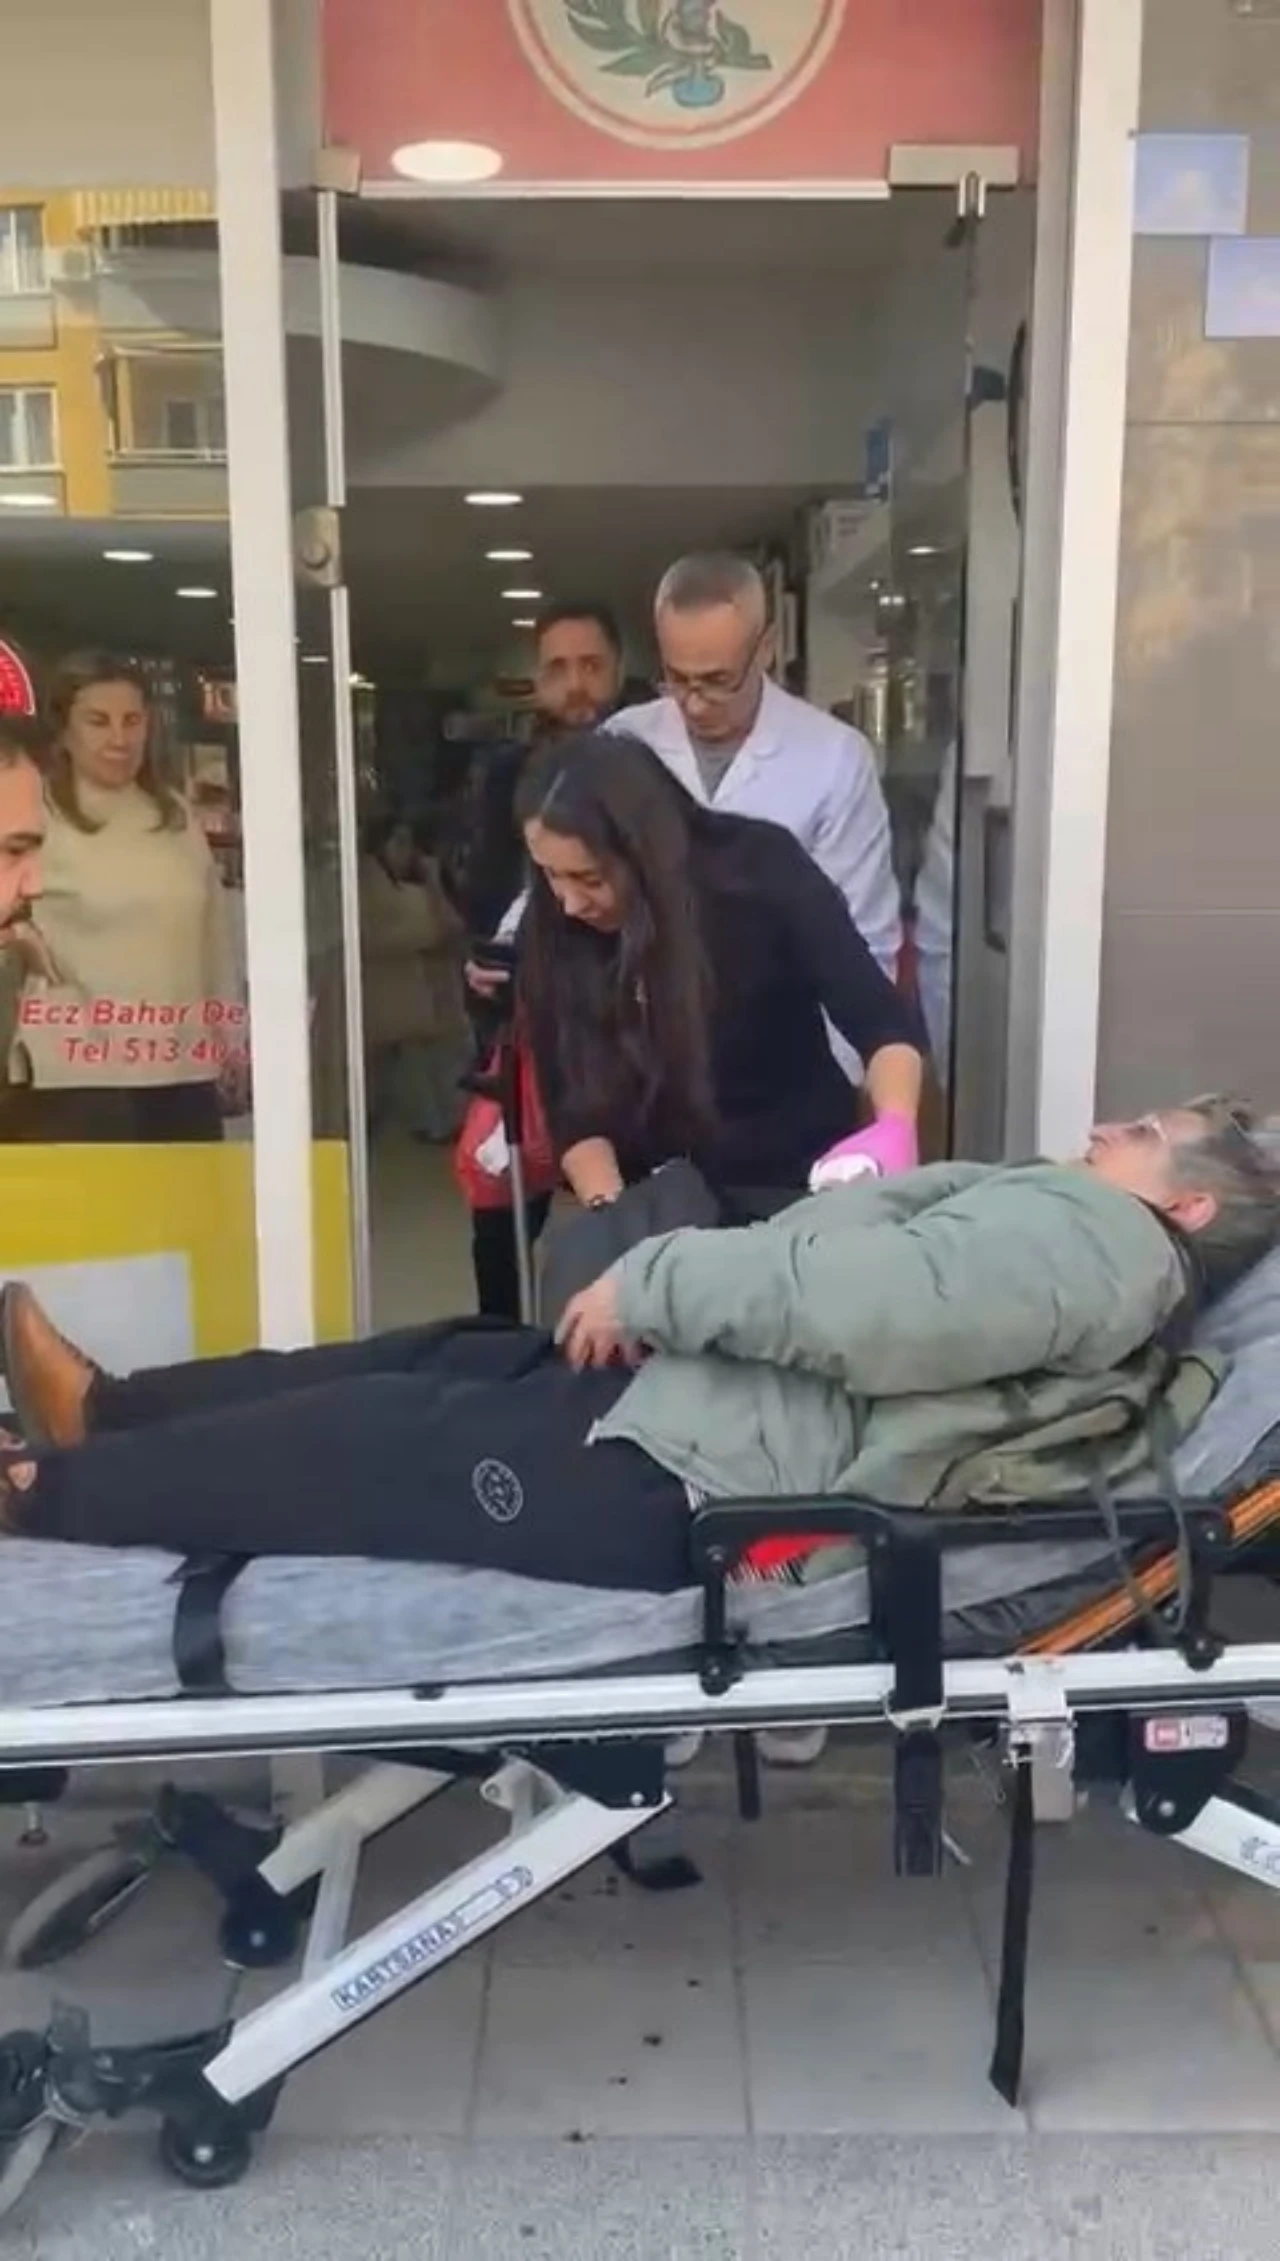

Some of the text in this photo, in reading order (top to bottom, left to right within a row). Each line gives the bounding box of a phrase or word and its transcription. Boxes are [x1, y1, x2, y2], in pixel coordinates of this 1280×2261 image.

[22, 1000, 79, 1025] Ecz
[93, 999, 190, 1025] Bahar
[65, 1037, 110, 1062] Tel
[125, 1036, 179, 1062] 513
[335, 1918, 457, 2010] KARTSANA
